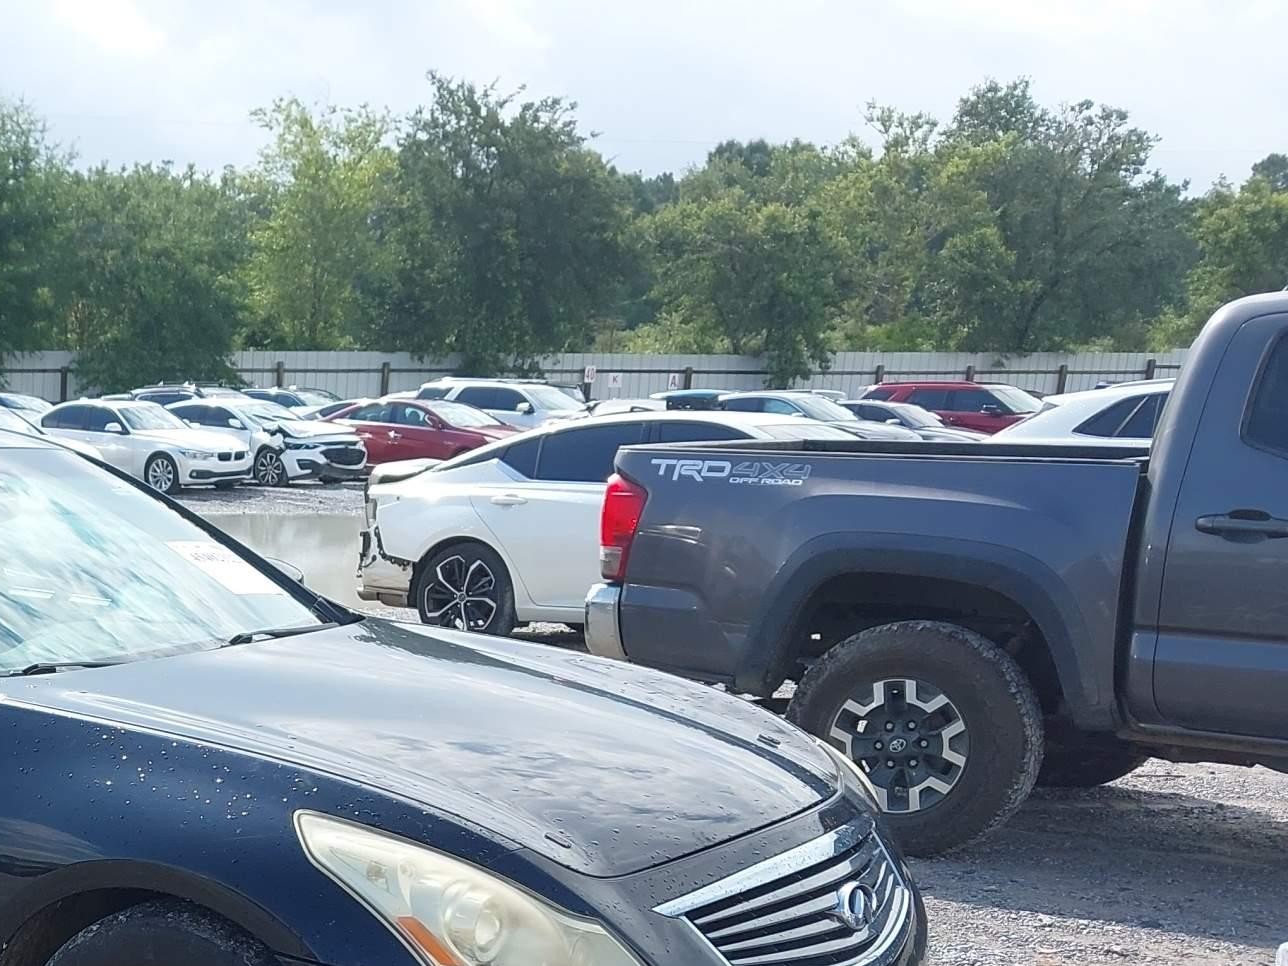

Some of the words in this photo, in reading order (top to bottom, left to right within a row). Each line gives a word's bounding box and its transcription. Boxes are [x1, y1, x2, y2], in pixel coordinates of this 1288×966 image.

[650, 458, 732, 482] TRD
[728, 476, 759, 485] OFF
[760, 477, 803, 486] ROAD
